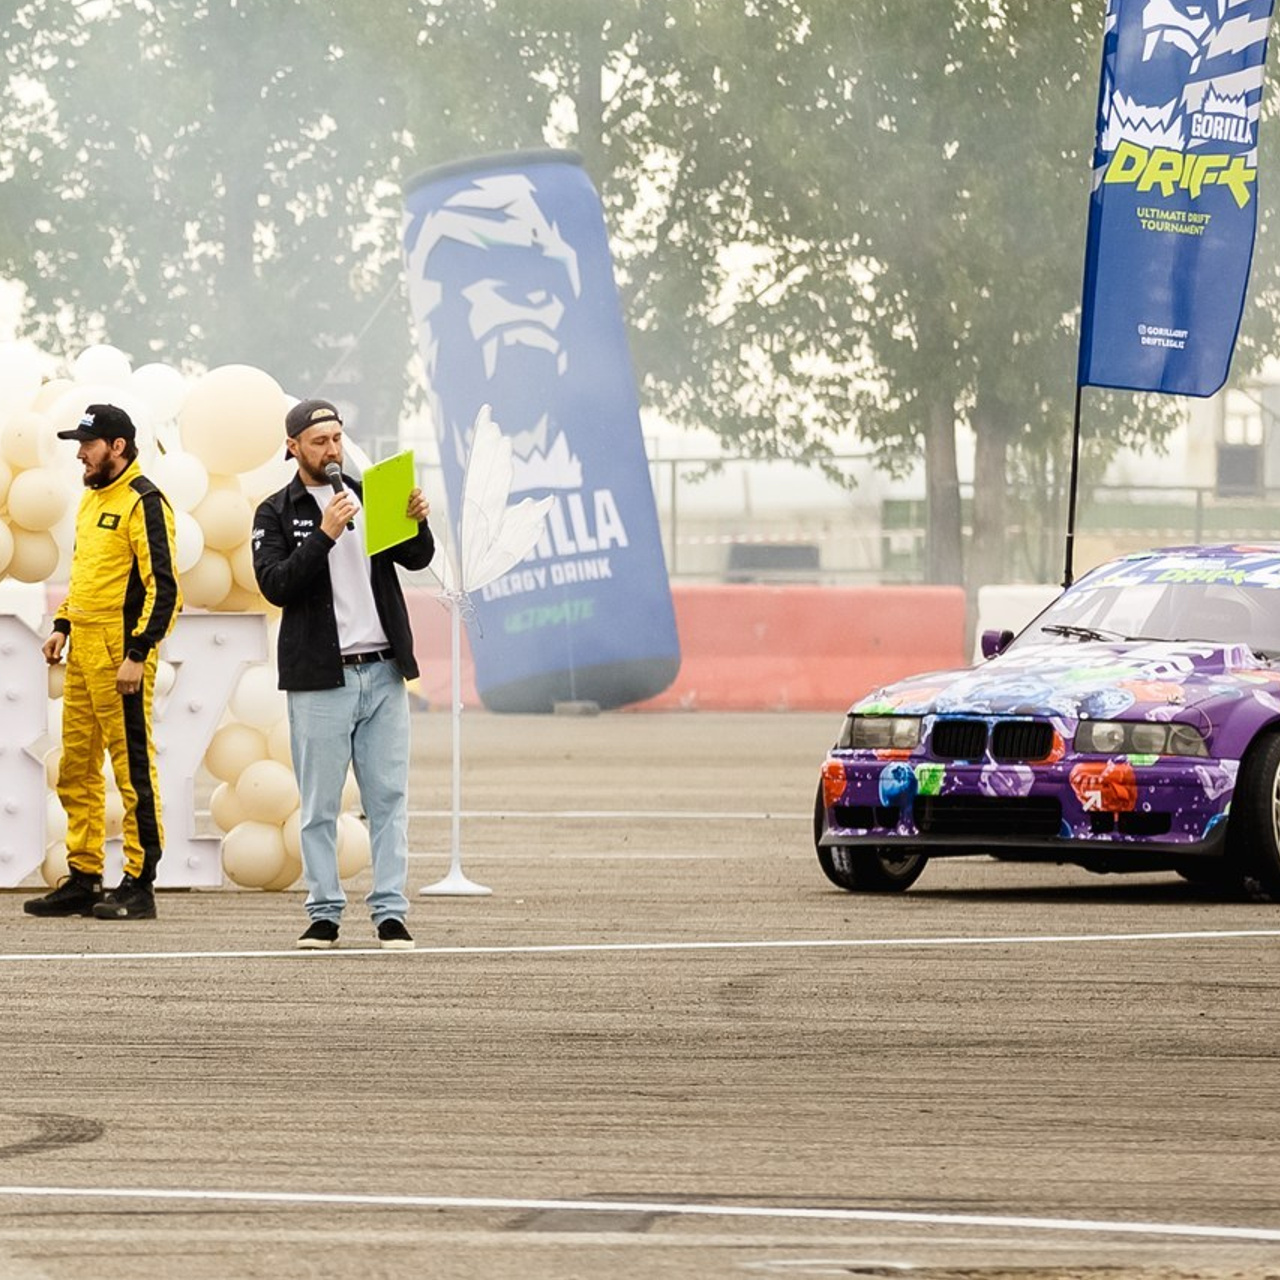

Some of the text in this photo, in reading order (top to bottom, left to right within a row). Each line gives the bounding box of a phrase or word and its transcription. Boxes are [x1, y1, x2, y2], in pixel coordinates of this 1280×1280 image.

[1191, 113, 1253, 145] GORILLA
[1104, 140, 1257, 209] DRIFT
[1137, 207, 1211, 225] ULTIMATE DRIFT
[1141, 219, 1205, 236] TOURNAMENT
[550, 557, 613, 586] DRINK
